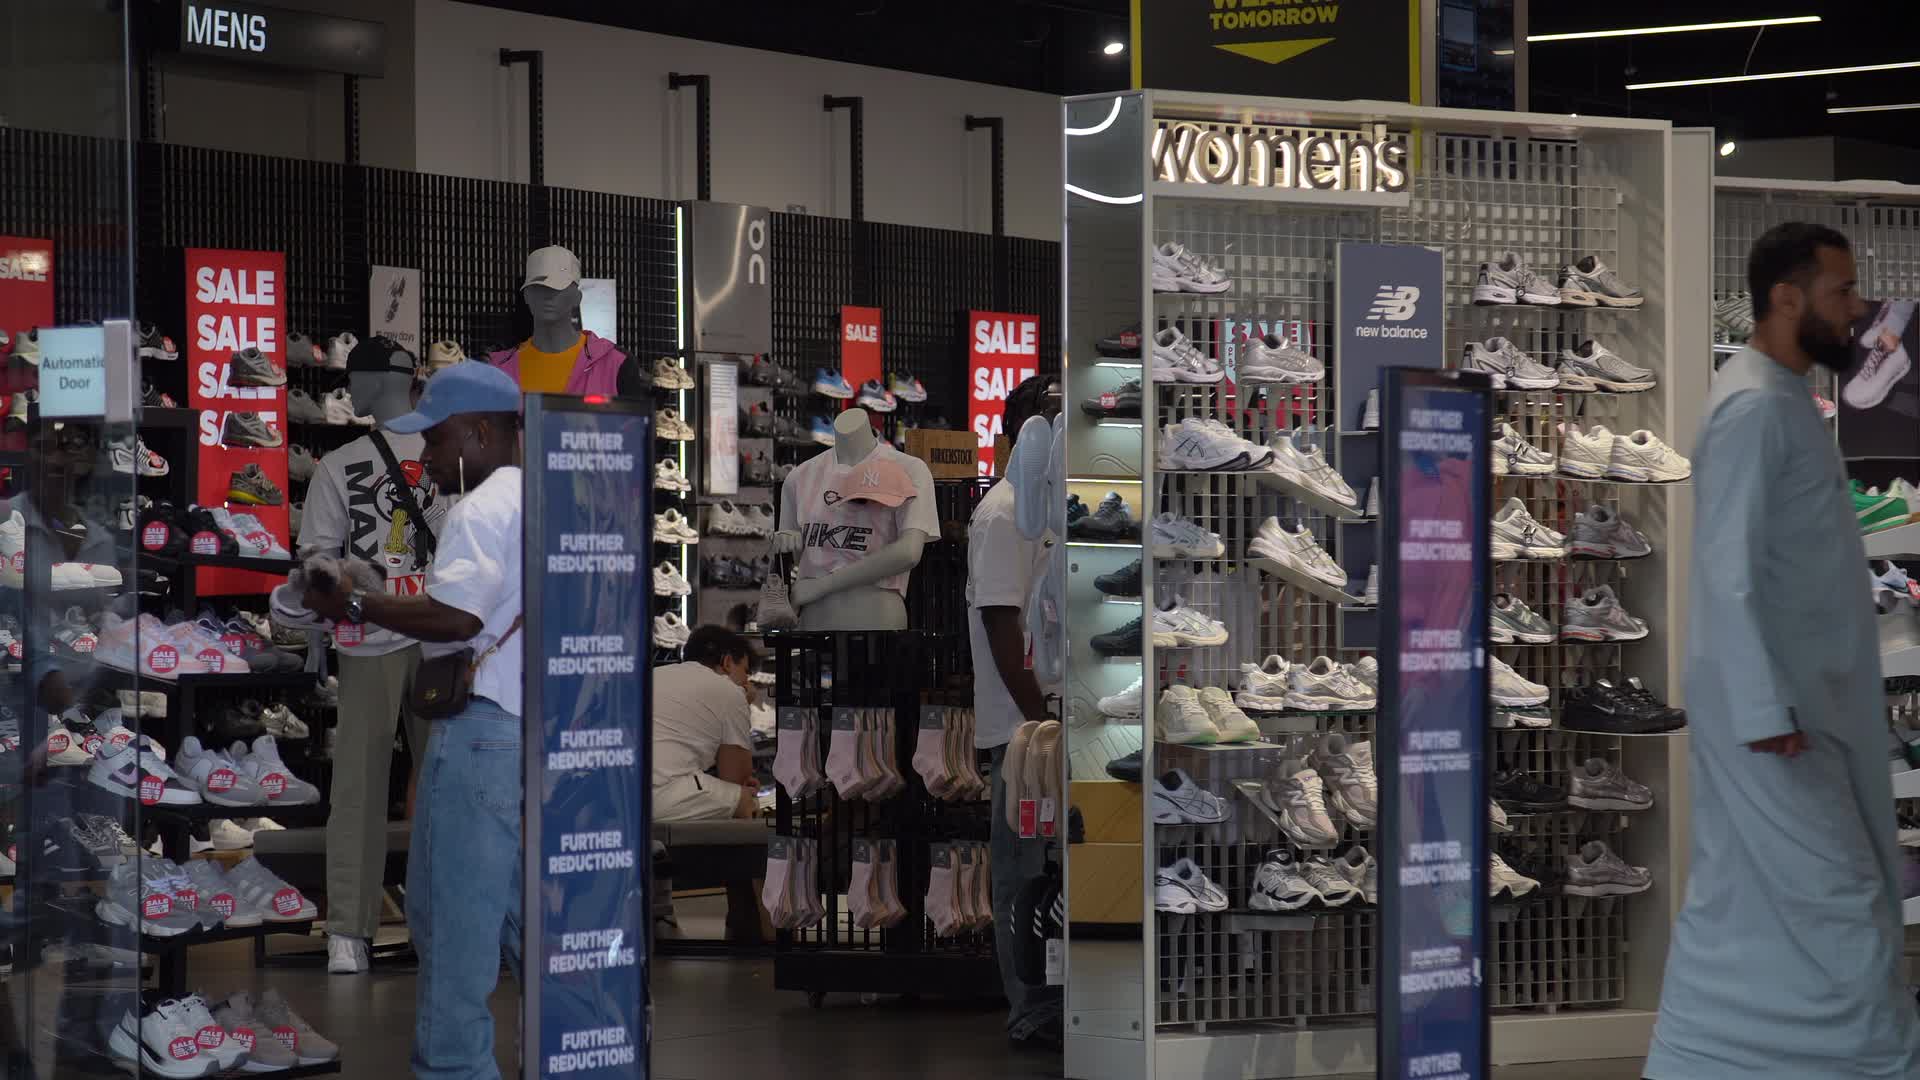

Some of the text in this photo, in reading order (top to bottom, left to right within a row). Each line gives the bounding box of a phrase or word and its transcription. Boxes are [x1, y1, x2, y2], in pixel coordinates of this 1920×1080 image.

[1209, 5, 1339, 30] TOMORROW
[187, 6, 266, 52] MENS
[1152, 127, 1408, 193] womens
[195, 267, 275, 305] SALE
[197, 315, 276, 353] SALE
[845, 324, 877, 343] SALE
[975, 320, 1035, 355] SALE
[1356, 324, 1428, 339] new balance
[59, 376, 91, 390] Door
[198, 362, 277, 400] SA
[560, 432, 623, 450] FURTHER
[548, 452, 633, 471] REDUCTIONS
[193, 537, 216, 545] SALE
[560, 534, 624, 552] FURTHER
[548, 555, 635, 573] REDUCTIONS
[561, 635, 624, 653] FURTHER
[548, 656, 634, 675] REDUCTIONS
[560, 729, 623, 748] FURTHER
[548, 749, 634, 770] REDUCTIONS
[560, 831, 622, 852] FURTHER
[1408, 841, 1461, 863] FURTHER
[549, 851, 633, 874] REDUCTIONS
[1400, 862, 1471, 886] REDUCTIONS
[276, 893, 297, 903] SALE
[562, 929, 623, 951] FURTHER
[549, 949, 635, 974] REDUCTIONS
[171, 1040, 194, 1049] SALE
[232, 1032, 254, 1042] SALE
[561, 1027, 625, 1051] FURTHER
[549, 1046, 634, 1074] REDUCTIONS
[1409, 1052, 1462, 1077] FURTHER
